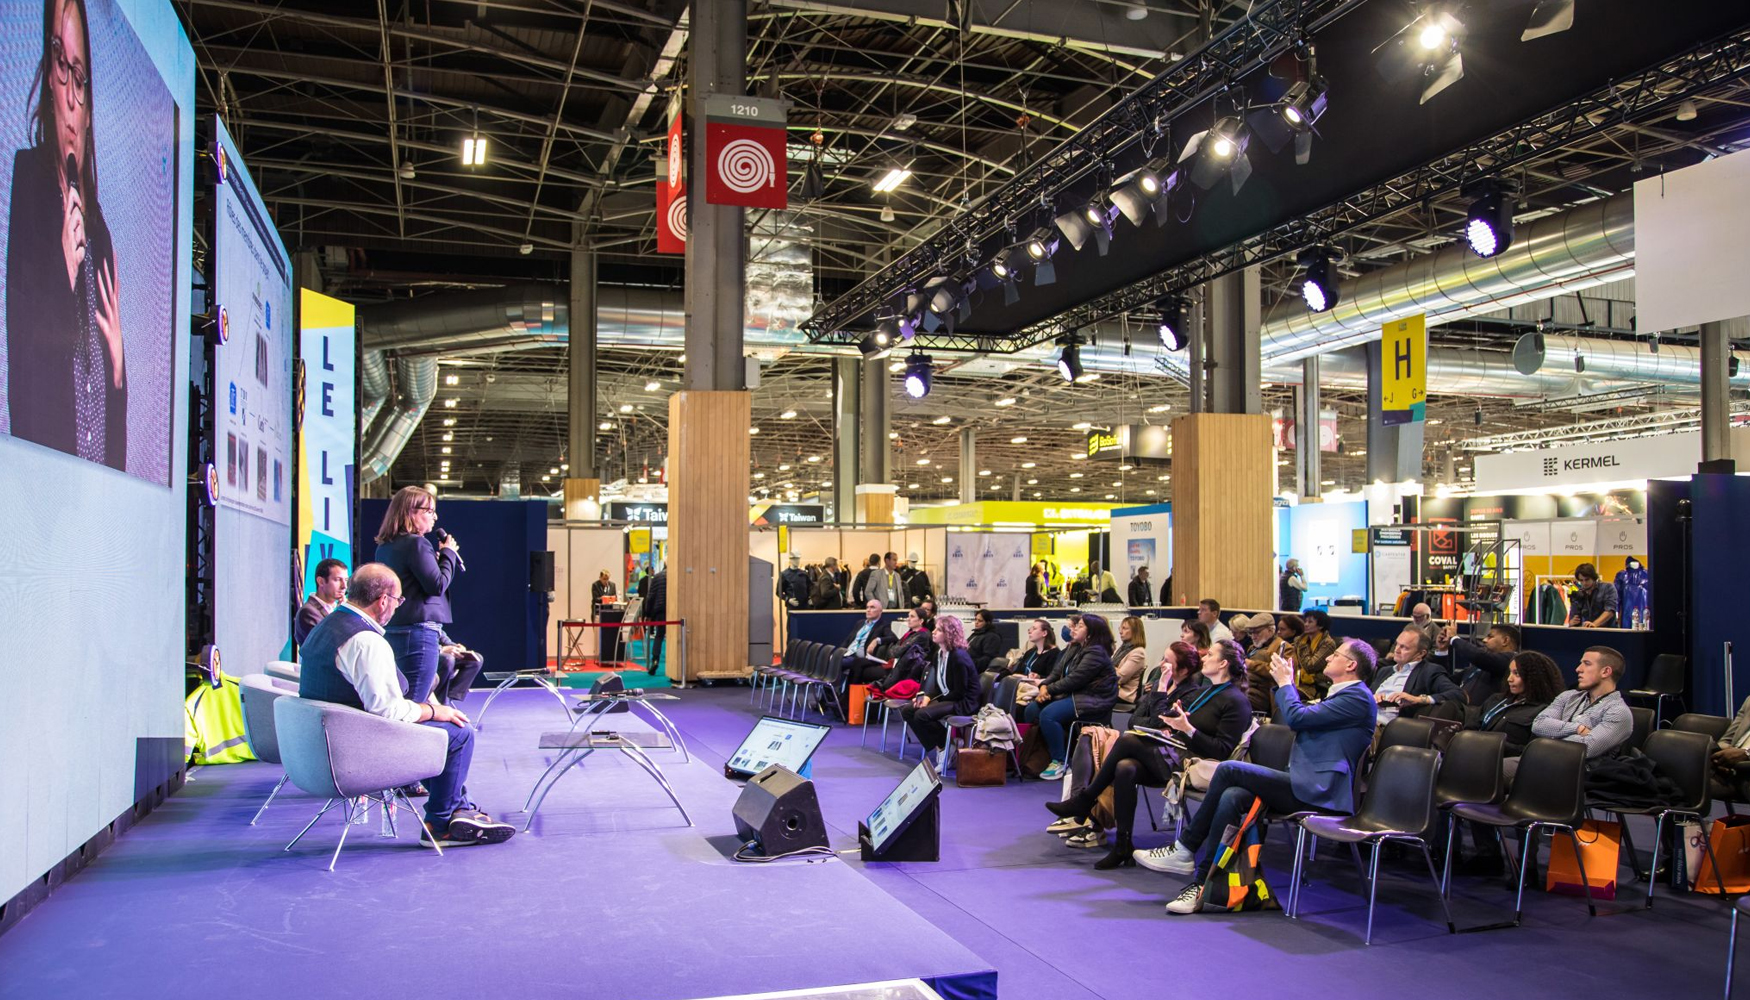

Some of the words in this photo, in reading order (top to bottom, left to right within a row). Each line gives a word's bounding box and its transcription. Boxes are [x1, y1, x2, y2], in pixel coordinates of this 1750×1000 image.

[731, 104, 758, 116] 1210
[1395, 338, 1411, 380] H
[322, 336, 334, 417] LE
[1390, 392, 1394, 403] J
[1412, 388, 1417, 399] G
[1564, 455, 1620, 471] KERMEL
[788, 513, 817, 522] Taiwan
[1130, 521, 1153, 532] TOYOBO
[1428, 556, 1457, 565] COVAL
